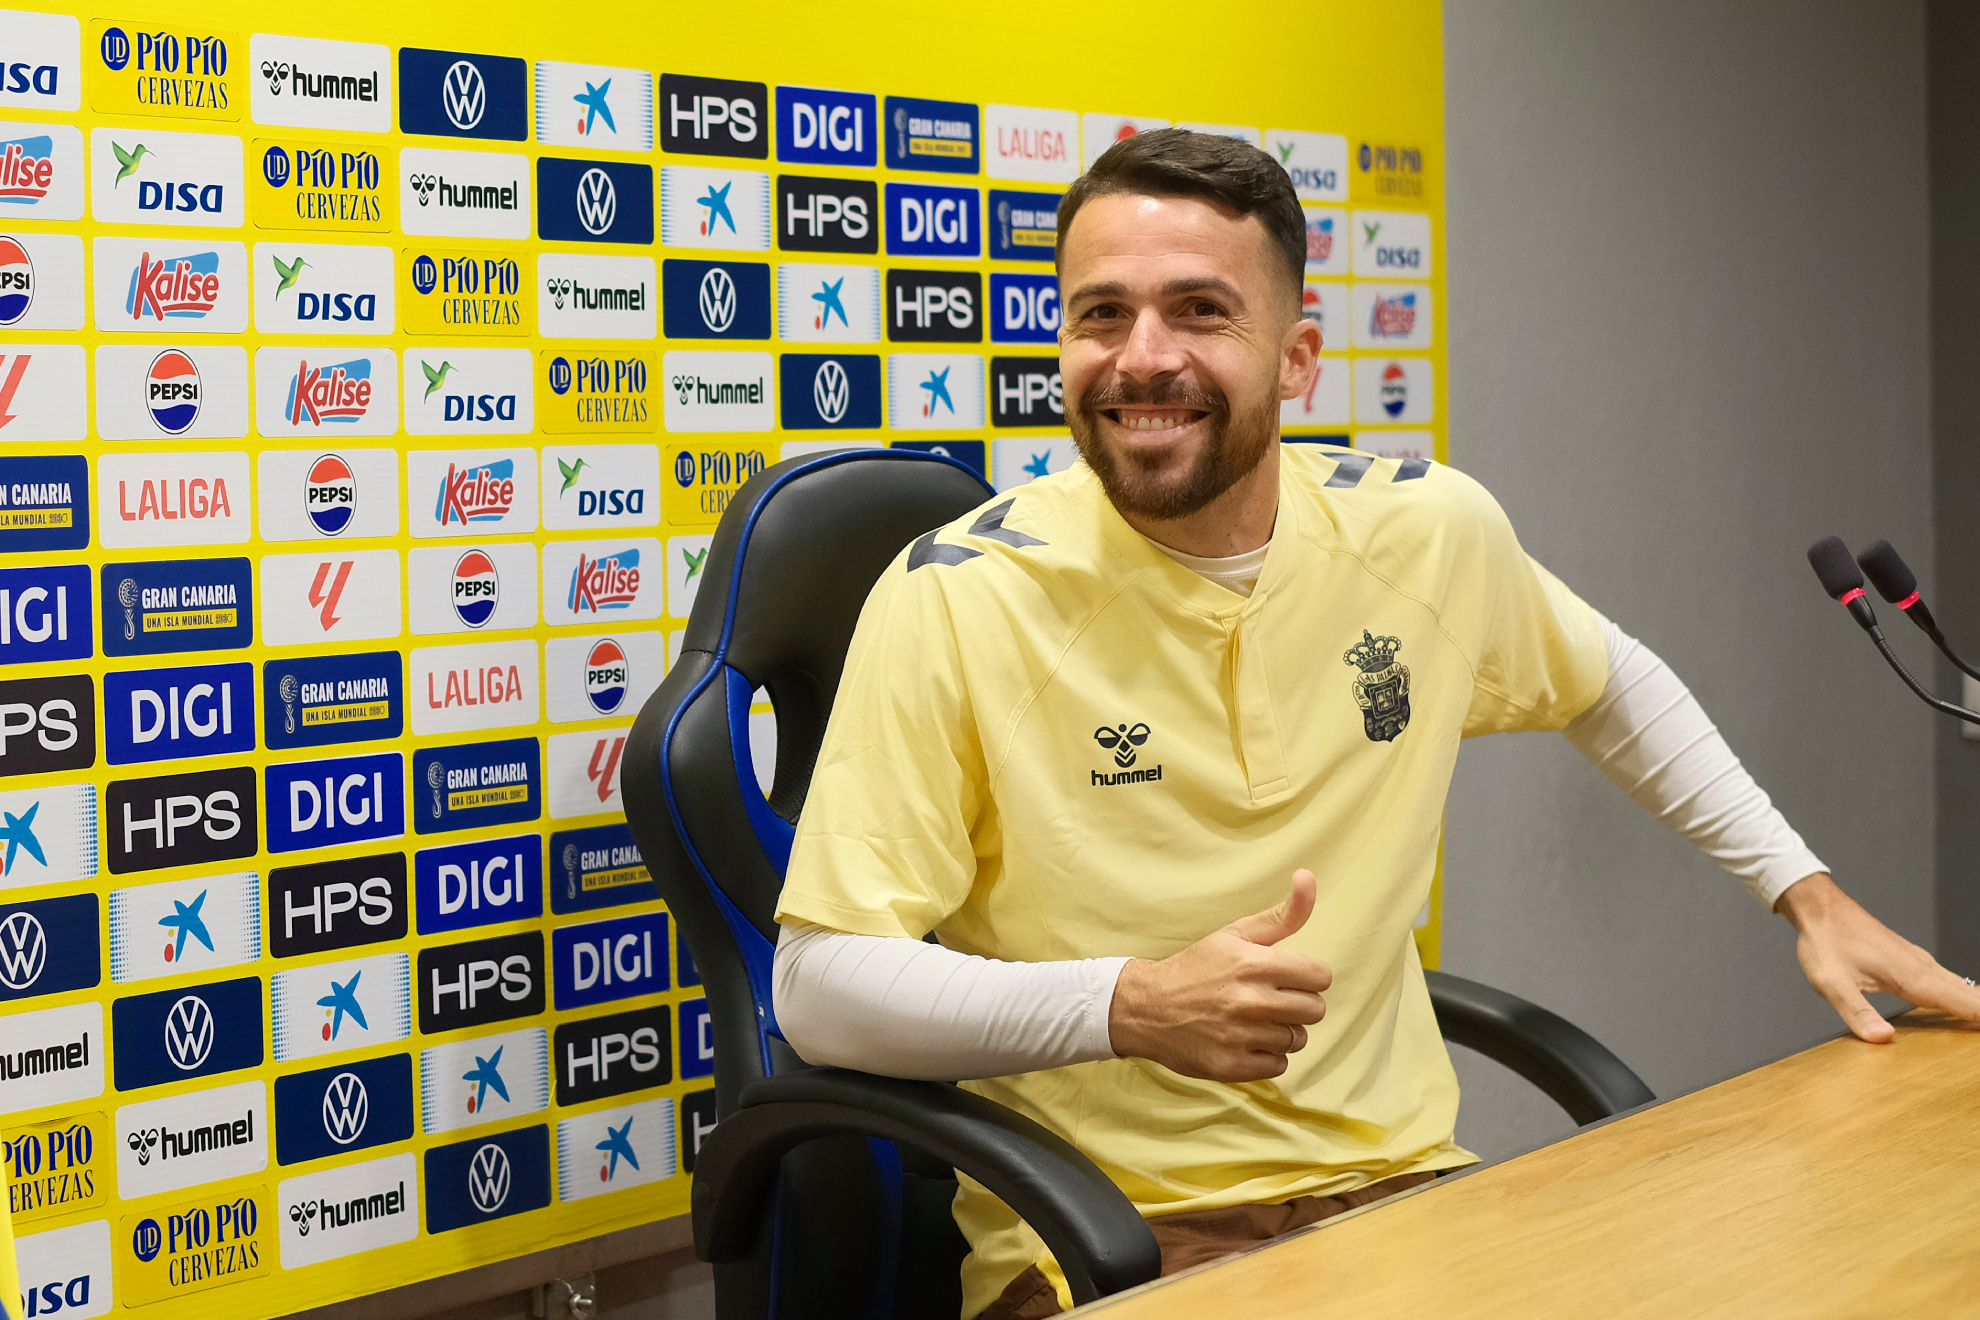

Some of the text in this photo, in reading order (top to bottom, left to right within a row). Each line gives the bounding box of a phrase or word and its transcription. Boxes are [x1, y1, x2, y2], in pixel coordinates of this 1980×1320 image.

[138, 77, 228, 109] CERVEZAS
[293, 64, 377, 102] hummel
[671, 94, 757, 142] HPS
[793, 103, 863, 152] DIGI
[999, 128, 1066, 161] LALIGA
[0, 145, 53, 188] lise
[297, 193, 380, 221] CERVEZAS
[439, 176, 517, 210] hummel
[787, 193, 868, 238] HPS
[901, 198, 967, 243] DIGI
[1, 272, 29, 290] PSI
[133, 251, 219, 322] Kalise
[574, 280, 644, 310] hummel
[443, 299, 520, 324] CERVEZAS
[896, 286, 973, 328] HPS
[1004, 286, 1059, 331] DIG
[151, 383, 197, 400] PEPSI
[292, 359, 371, 427] Kalise
[577, 398, 647, 422] CERVEZAS
[697, 377, 763, 404] hummel
[12, 483, 71, 505] CANARIA
[120, 478, 230, 521] LALIGA
[309, 487, 352, 503] PEPSI
[442, 462, 514, 527] Kalise
[701, 489, 738, 513] CERV
[13, 514, 46, 525] MUNDIAL
[142, 585, 236, 609] GRAN CANARIA
[456, 581, 495, 597] PEPSI
[573, 553, 640, 614] Kalise
[0, 586, 67, 644] IGI
[147, 617, 161, 628] UNA
[164, 616, 179, 627] ISLA
[182, 614, 213, 626] MUNDIAL
[302, 678, 388, 704] GRAN CANARIA
[429, 666, 522, 709] LALIGA
[589, 668, 625, 685] PEPSI
[0, 700, 77, 756] PS
[131, 682, 231, 743] DIGI
[306, 712, 319, 722] UNA
[322, 710, 336, 721] ISLA
[338, 708, 367, 719] MUNDIAL
[448, 762, 527, 789] GRAN CANARIA
[1091, 765, 1162, 786] hummel
[290, 772, 382, 832] DIGI
[452, 796, 464, 807] UNA
[466, 794, 479, 805] ISLA
[482, 791, 507, 803] MUNDIAL
[124, 791, 240, 853] HPS
[581, 845, 643, 870] GRAN CANA
[439, 854, 523, 914] DIGI
[285, 878, 392, 938] HPS
[574, 931, 652, 990] DIGI
[432, 955, 531, 1014] HPS
[568, 1028, 659, 1087] HPS
[162, 1110, 253, 1160] hummel
[10, 1170, 94, 1213] ERVEZAS
[321, 1181, 404, 1230] hummel
[170, 1241, 258, 1286] CERVEZAS
